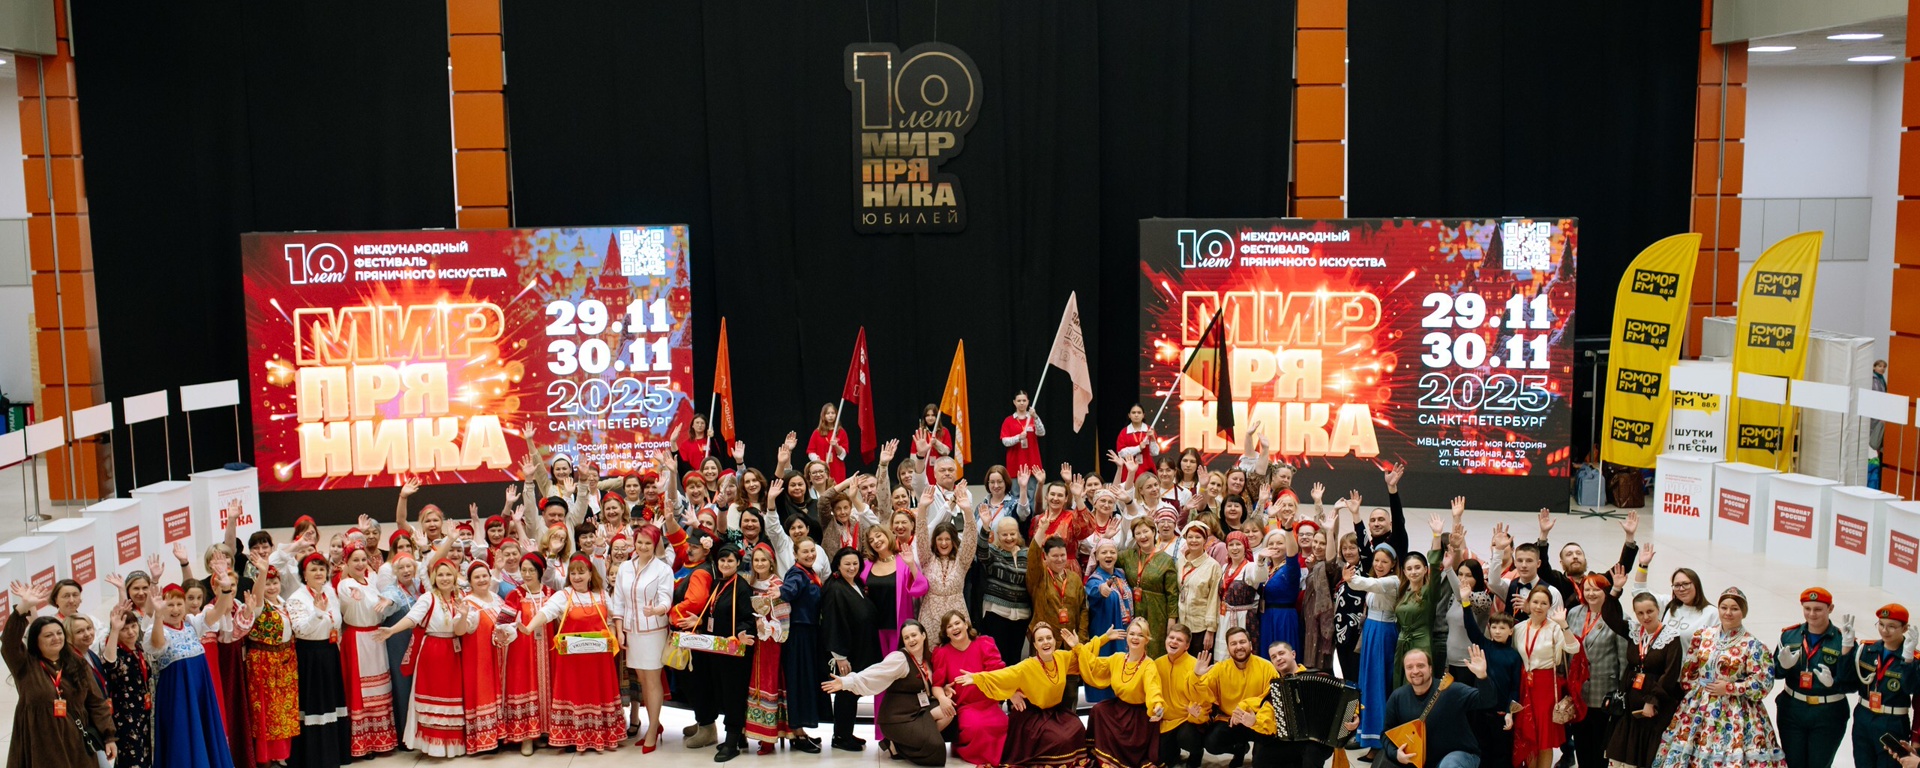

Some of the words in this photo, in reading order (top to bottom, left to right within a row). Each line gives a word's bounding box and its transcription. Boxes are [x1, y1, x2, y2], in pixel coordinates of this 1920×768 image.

[853, 51, 975, 129] 10
[899, 110, 970, 129] лет
[861, 131, 956, 157] МИР
[862, 158, 929, 182] ПРЯ
[862, 183, 957, 207] НИКА
[862, 209, 958, 225] ЮБИЛЕЙ
[1240, 230, 1350, 242] МЕЖДУНАРОДНЫЙ
[353, 241, 469, 255] МЕЖДУНАРОДНЫЙ
[1178, 229, 1235, 268] 10
[1240, 244, 1310, 255] ФЕСТИВАЛЬ
[284, 242, 348, 285] 10
[353, 256, 428, 268] ФЕСТИВАЛЬ
[1198, 257, 1232, 268] лет
[1240, 257, 1317, 267] ПРЯНИЧНОГО
[1319, 257, 1387, 268] ИСКУССТВА
[309, 271, 347, 284] лет
[354, 269, 436, 282] ПРЯНИЧНОГО
[438, 267, 507, 279] ИСКУССТВА
[1636, 270, 1677, 287] ЮМОР
[1758, 272, 1799, 288] ЮМОР
[1634, 281, 1654, 292] FM
[1659, 287, 1674, 296] 88.9
[1756, 284, 1776, 294] FM
[1782, 288, 1797, 296] 88.9
[545, 298, 670, 336] 29.11
[1182, 290, 1382, 346] МИР
[1421, 292, 1550, 329] 29.11
[294, 302, 505, 365] МИР
[1627, 319, 1668, 336] ЮМОР
[1752, 324, 1793, 340] ЮМОР
[1625, 331, 1645, 342] FM
[1650, 337, 1665, 345] 88.9
[1750, 335, 1770, 345] FM
[547, 337, 672, 375] 30.11
[1421, 332, 1550, 369] 30.11
[1180, 347, 1323, 401] ПРЯ
[1620, 369, 1659, 386] ЮМОР
[295, 362, 449, 422] ПРЯ
[1417, 372, 1550, 411] 2025
[1618, 380, 1637, 391] FM
[1642, 386, 1657, 394] 88.9
[546, 376, 675, 416] 2025
[1674, 397, 1694, 407] FM
[548, 416, 672, 431] САНКТ-ПЕТЕРБУРГ
[1418, 414, 1547, 427] САНКТ-ПЕТЕРБУРГ
[1613, 419, 1651, 435] ЮМОР
[1179, 400, 1381, 458] НИКА
[1613, 429, 1630, 440] FM
[1674, 428, 1713, 438] ШУТКИ
[1741, 426, 1781, 441] ЮМОР
[299, 414, 513, 479] НИКА
[548, 444, 571, 452] МВЦ
[572, 443, 608, 452] «Россия
[1416, 438, 1439, 447] МВЦ
[1441, 438, 1478, 447] «Россия
[1505, 441, 1547, 450] история»
[1740, 437, 1759, 447] FM
[644, 450, 654, 458] 32
[1453, 449, 1504, 459] Бассейная,
[1505, 451, 1513, 459] д.
[1515, 450, 1526, 458] 32
[620, 460, 654, 469] Победы
[1462, 459, 1486, 468] Парк
[1488, 459, 1525, 469] Победы
[1664, 492, 1690, 505] ПРЯ
[1663, 503, 1700, 517] НИКА
[221, 514, 253, 530] НКА
